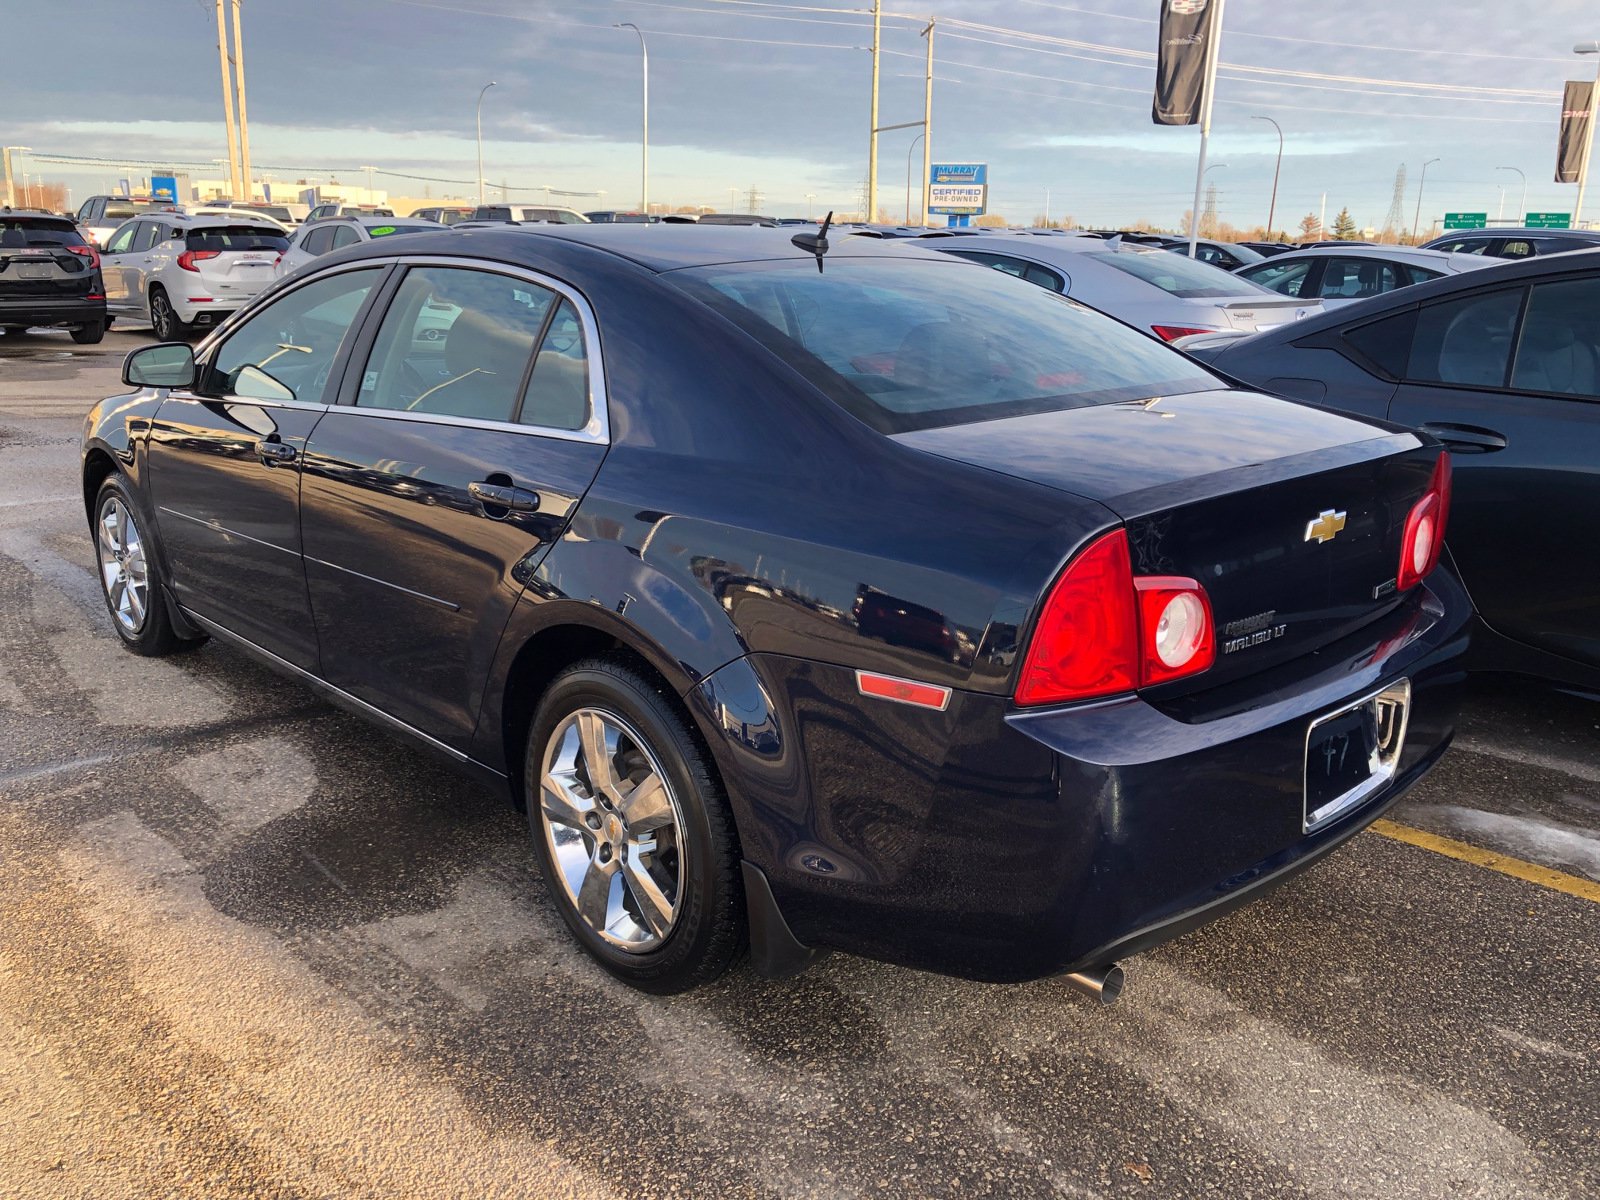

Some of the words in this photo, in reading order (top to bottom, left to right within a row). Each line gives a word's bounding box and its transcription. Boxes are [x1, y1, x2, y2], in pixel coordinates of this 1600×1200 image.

[938, 166, 977, 174] MURRAY
[1225, 629, 1272, 654] MALIBU
[1274, 624, 1287, 637] LT
